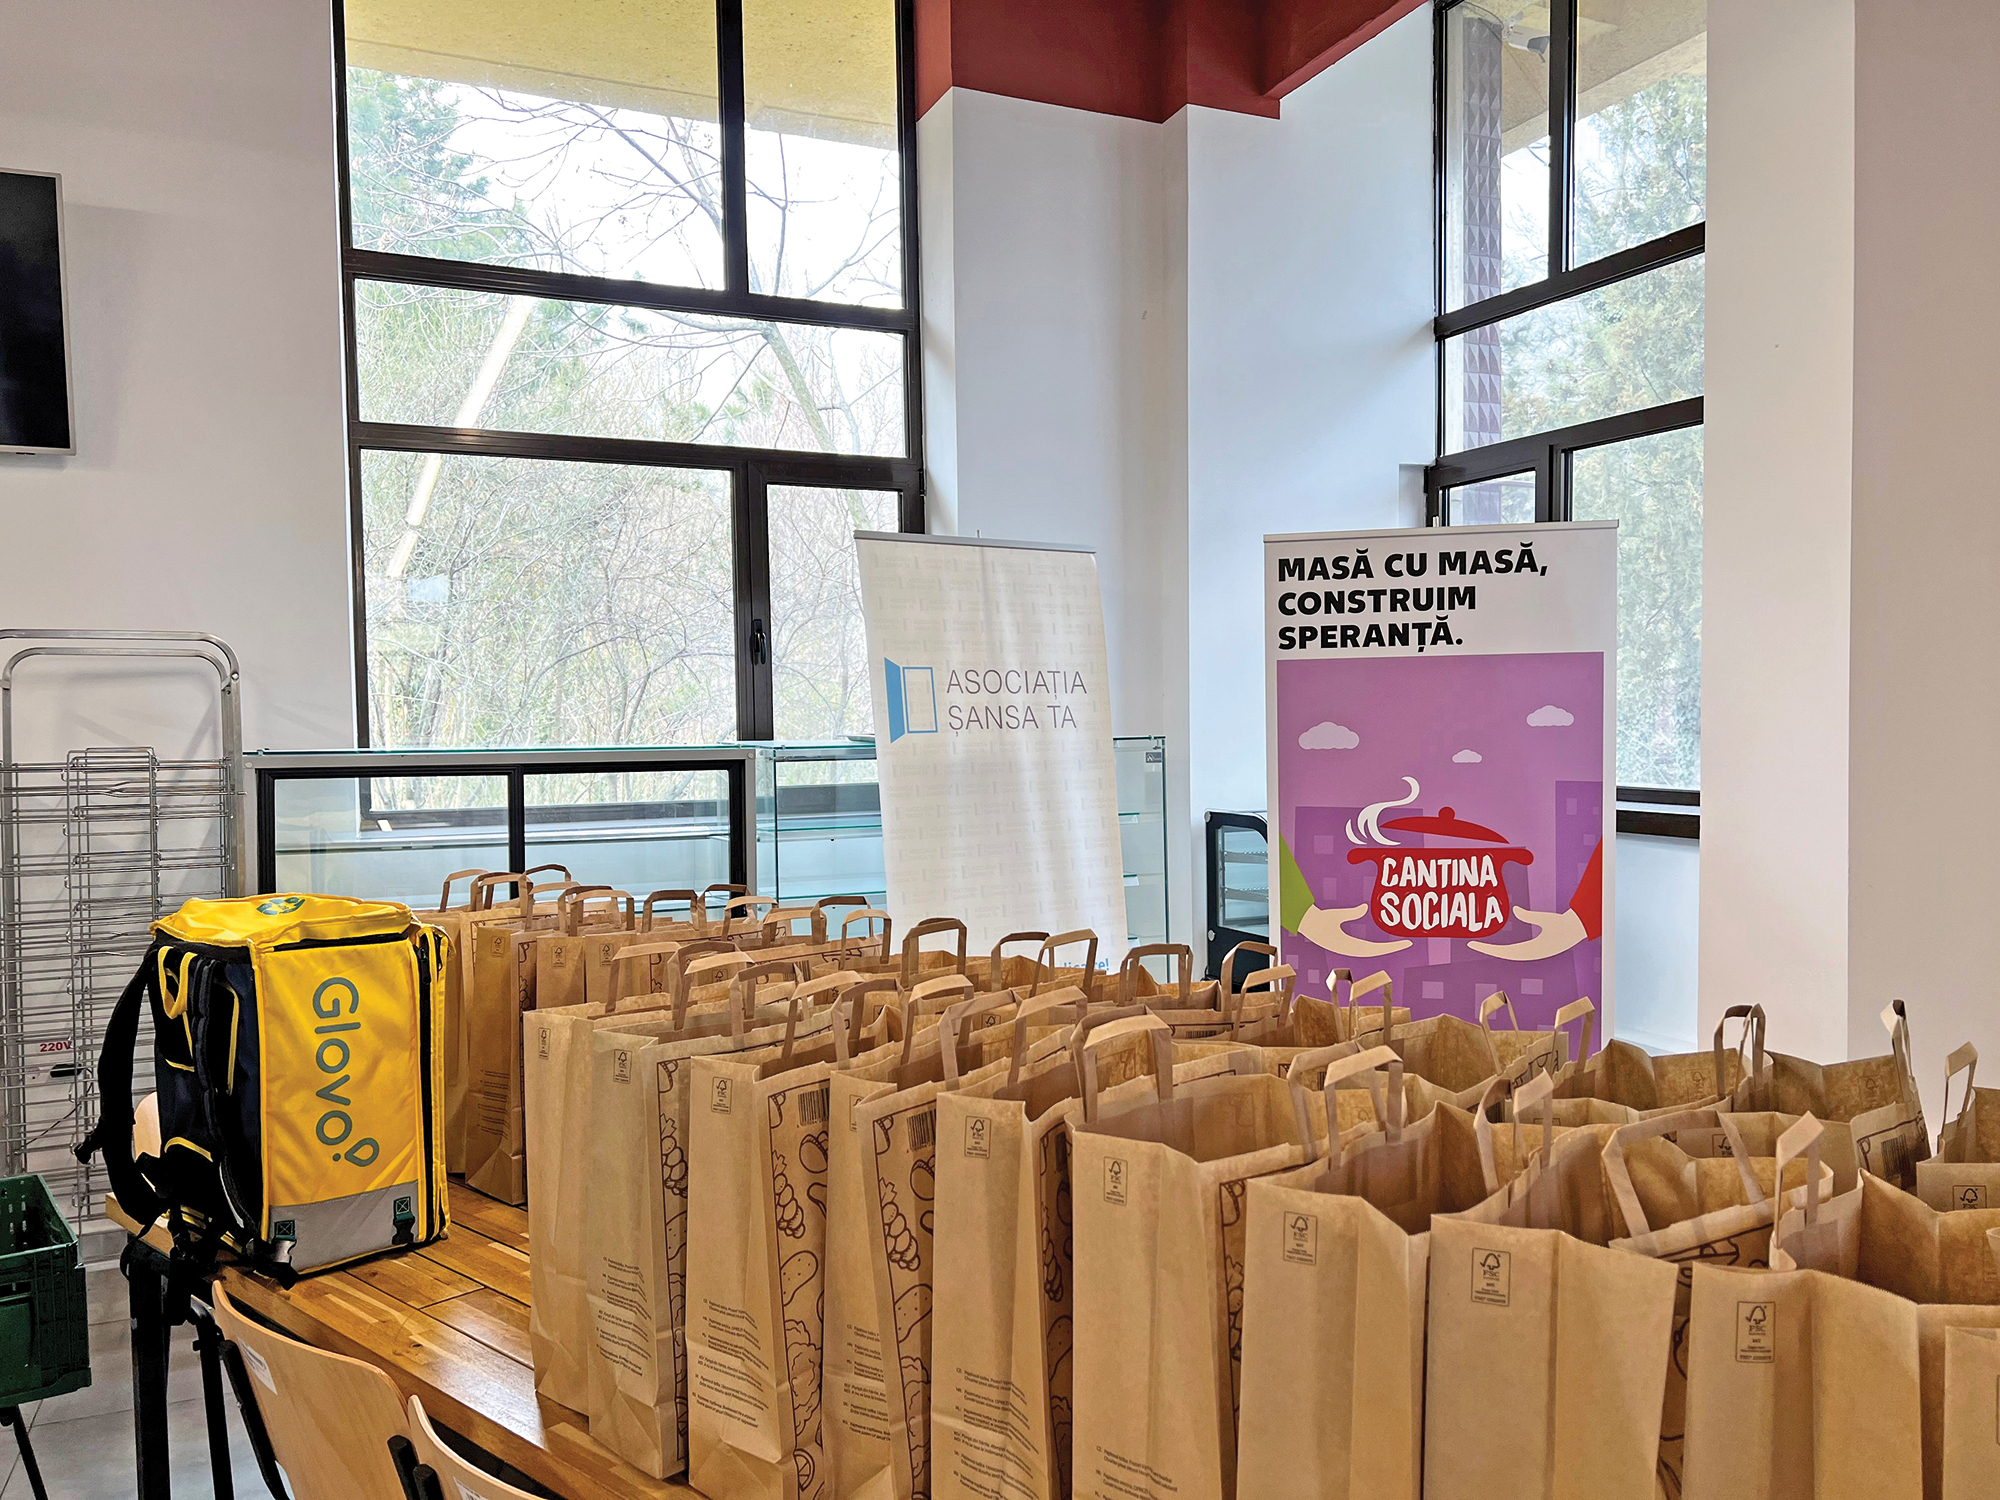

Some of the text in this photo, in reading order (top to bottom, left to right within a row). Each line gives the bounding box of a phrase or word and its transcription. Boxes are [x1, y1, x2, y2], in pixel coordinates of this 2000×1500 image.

[1278, 542, 1548, 582] MASĂ CU MASĂ,
[1277, 585, 1476, 616] CONSTRUIM
[1278, 614, 1463, 653] SPERANȚĂ.
[946, 669, 1088, 700] ASOCIAȚIA
[948, 705, 1077, 737] ȘANSA TA
[1381, 855, 1498, 889] CANTINA
[1380, 891, 1504, 932] SOCIALA
[39, 1041, 73, 1053] 220V
[312, 976, 362, 1147] Glovo
